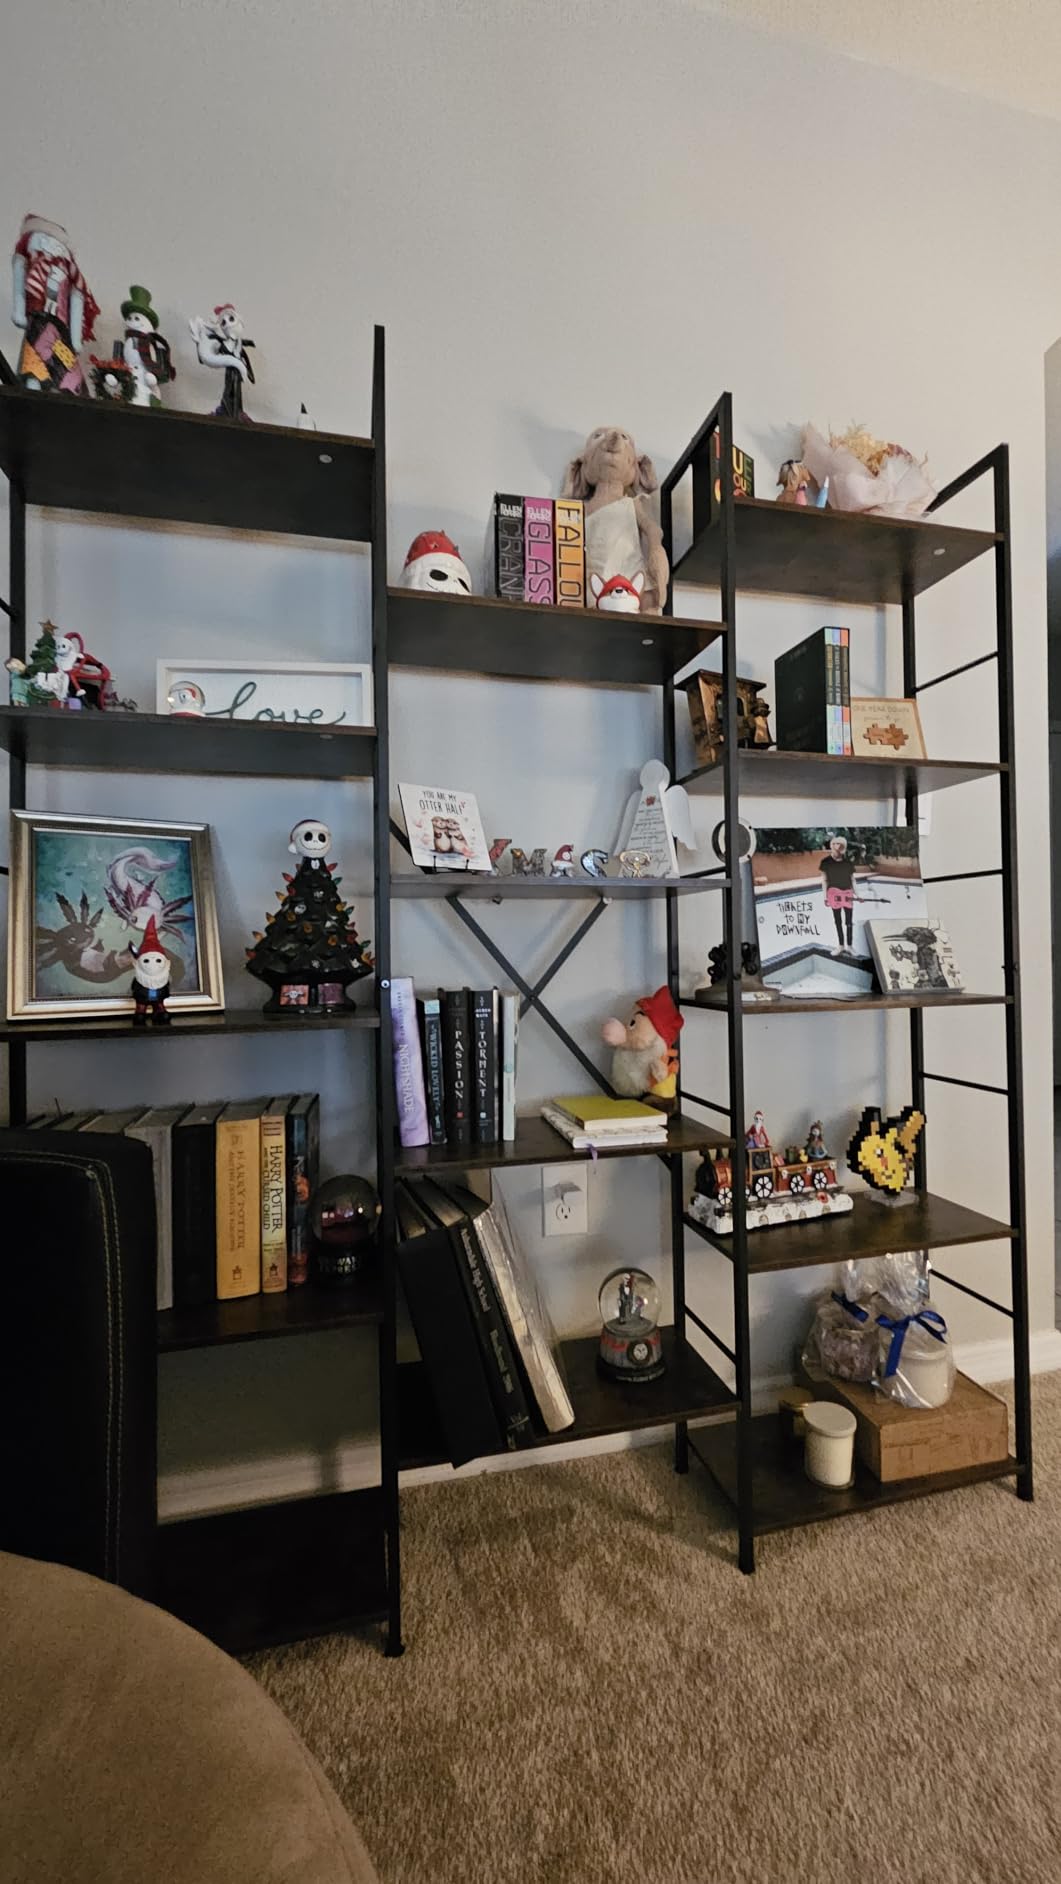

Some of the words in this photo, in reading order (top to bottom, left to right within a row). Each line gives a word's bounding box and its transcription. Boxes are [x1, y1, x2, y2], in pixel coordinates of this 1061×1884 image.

[499, 517, 523, 600] CRAN
[419, 799, 443, 813] OTTER
[445, 803, 463, 815] HALF
[422, 790, 434, 799] YOU
[448, 793, 457, 803] MY
[399, 1045, 415, 1113] NIGHTSHADE
[454, 1030, 464, 1099] PASSION
[478, 1031, 488, 1098] TORMENT
[236, 1151, 246, 1198] HARRY
[270, 1145, 283, 1184] HARRY
[236, 1202, 246, 1249] POTTER
[262, 1203, 270, 1230] CHILD
[270, 1188, 283, 1233] POTTER
